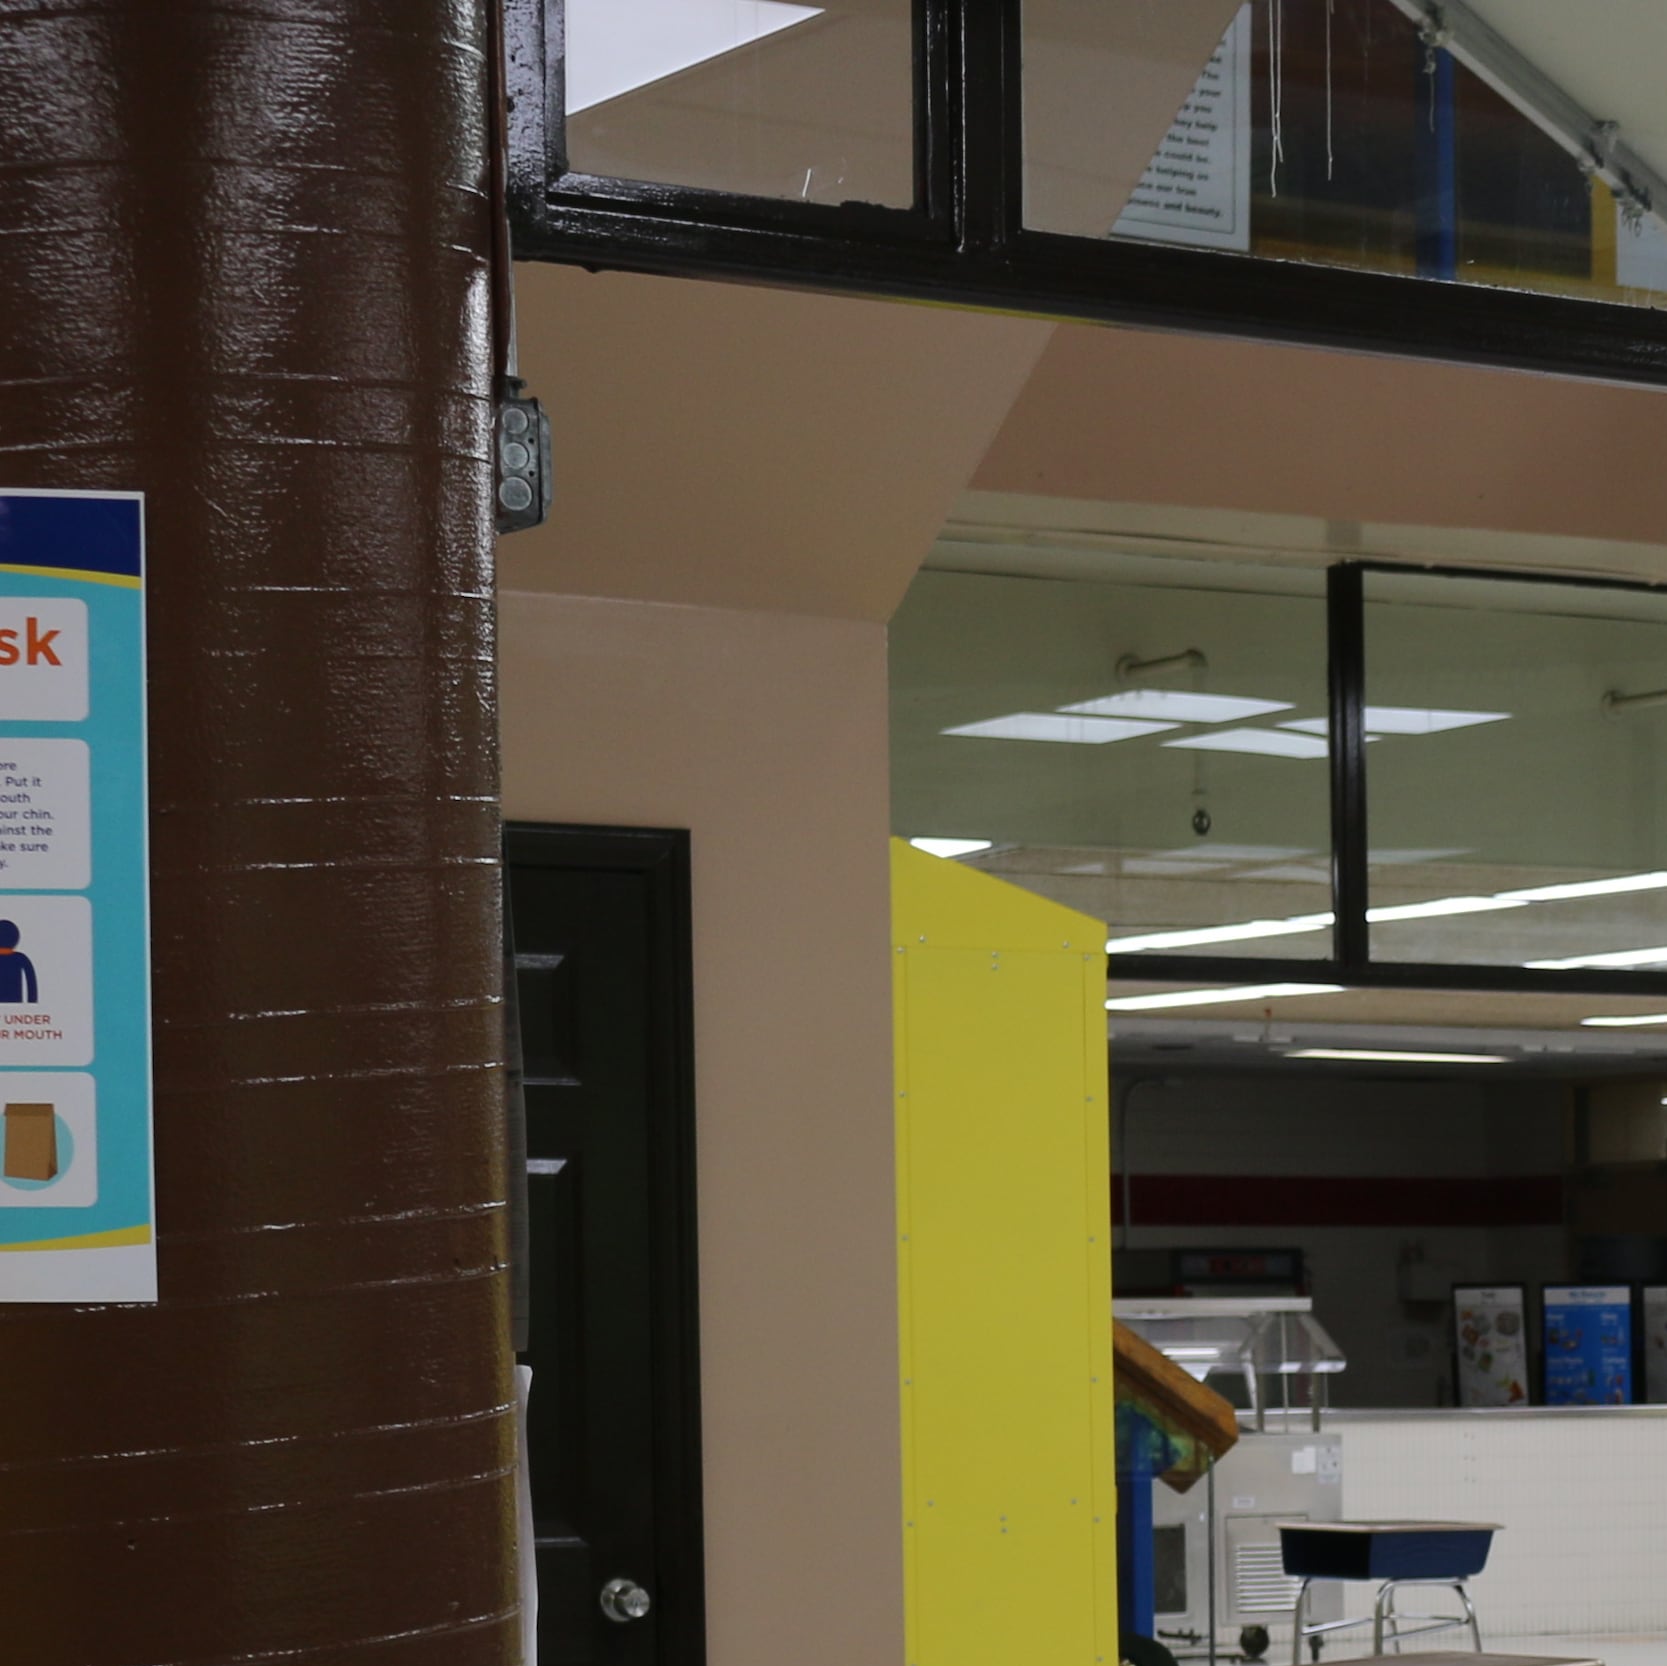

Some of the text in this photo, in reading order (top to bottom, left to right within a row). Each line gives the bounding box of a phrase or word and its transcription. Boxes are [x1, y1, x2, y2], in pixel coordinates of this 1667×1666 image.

[5, 776, 43, 788] Put it
[22, 808, 55, 821] chin.
[30, 825, 54, 837] the
[20, 842, 49, 853] sure
[4, 1014, 51, 1025] UNDER
[14, 1029, 63, 1041] MOUTH
